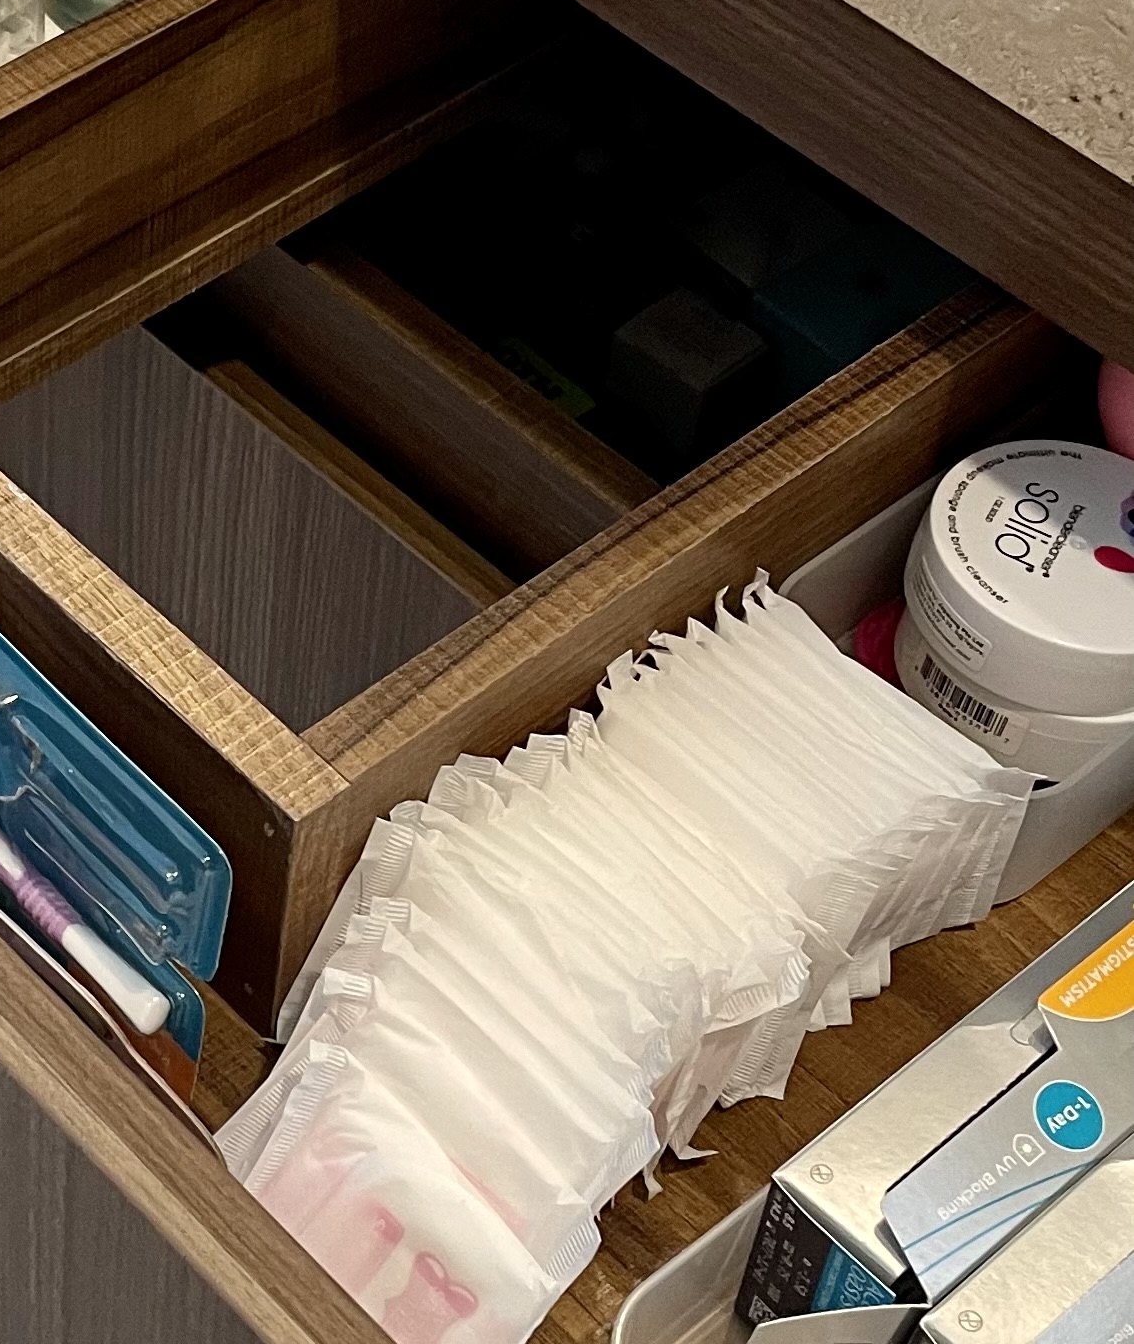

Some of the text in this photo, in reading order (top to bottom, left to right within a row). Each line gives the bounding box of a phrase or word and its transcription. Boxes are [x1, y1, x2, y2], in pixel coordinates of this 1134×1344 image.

[995, 482, 1059, 569] solid
[1059, 934, 1134, 1008] STIGMATISM
[1046, 1095, 1091, 1134] 1-Day
[937, 1156, 1018, 1221] UV Blocking
